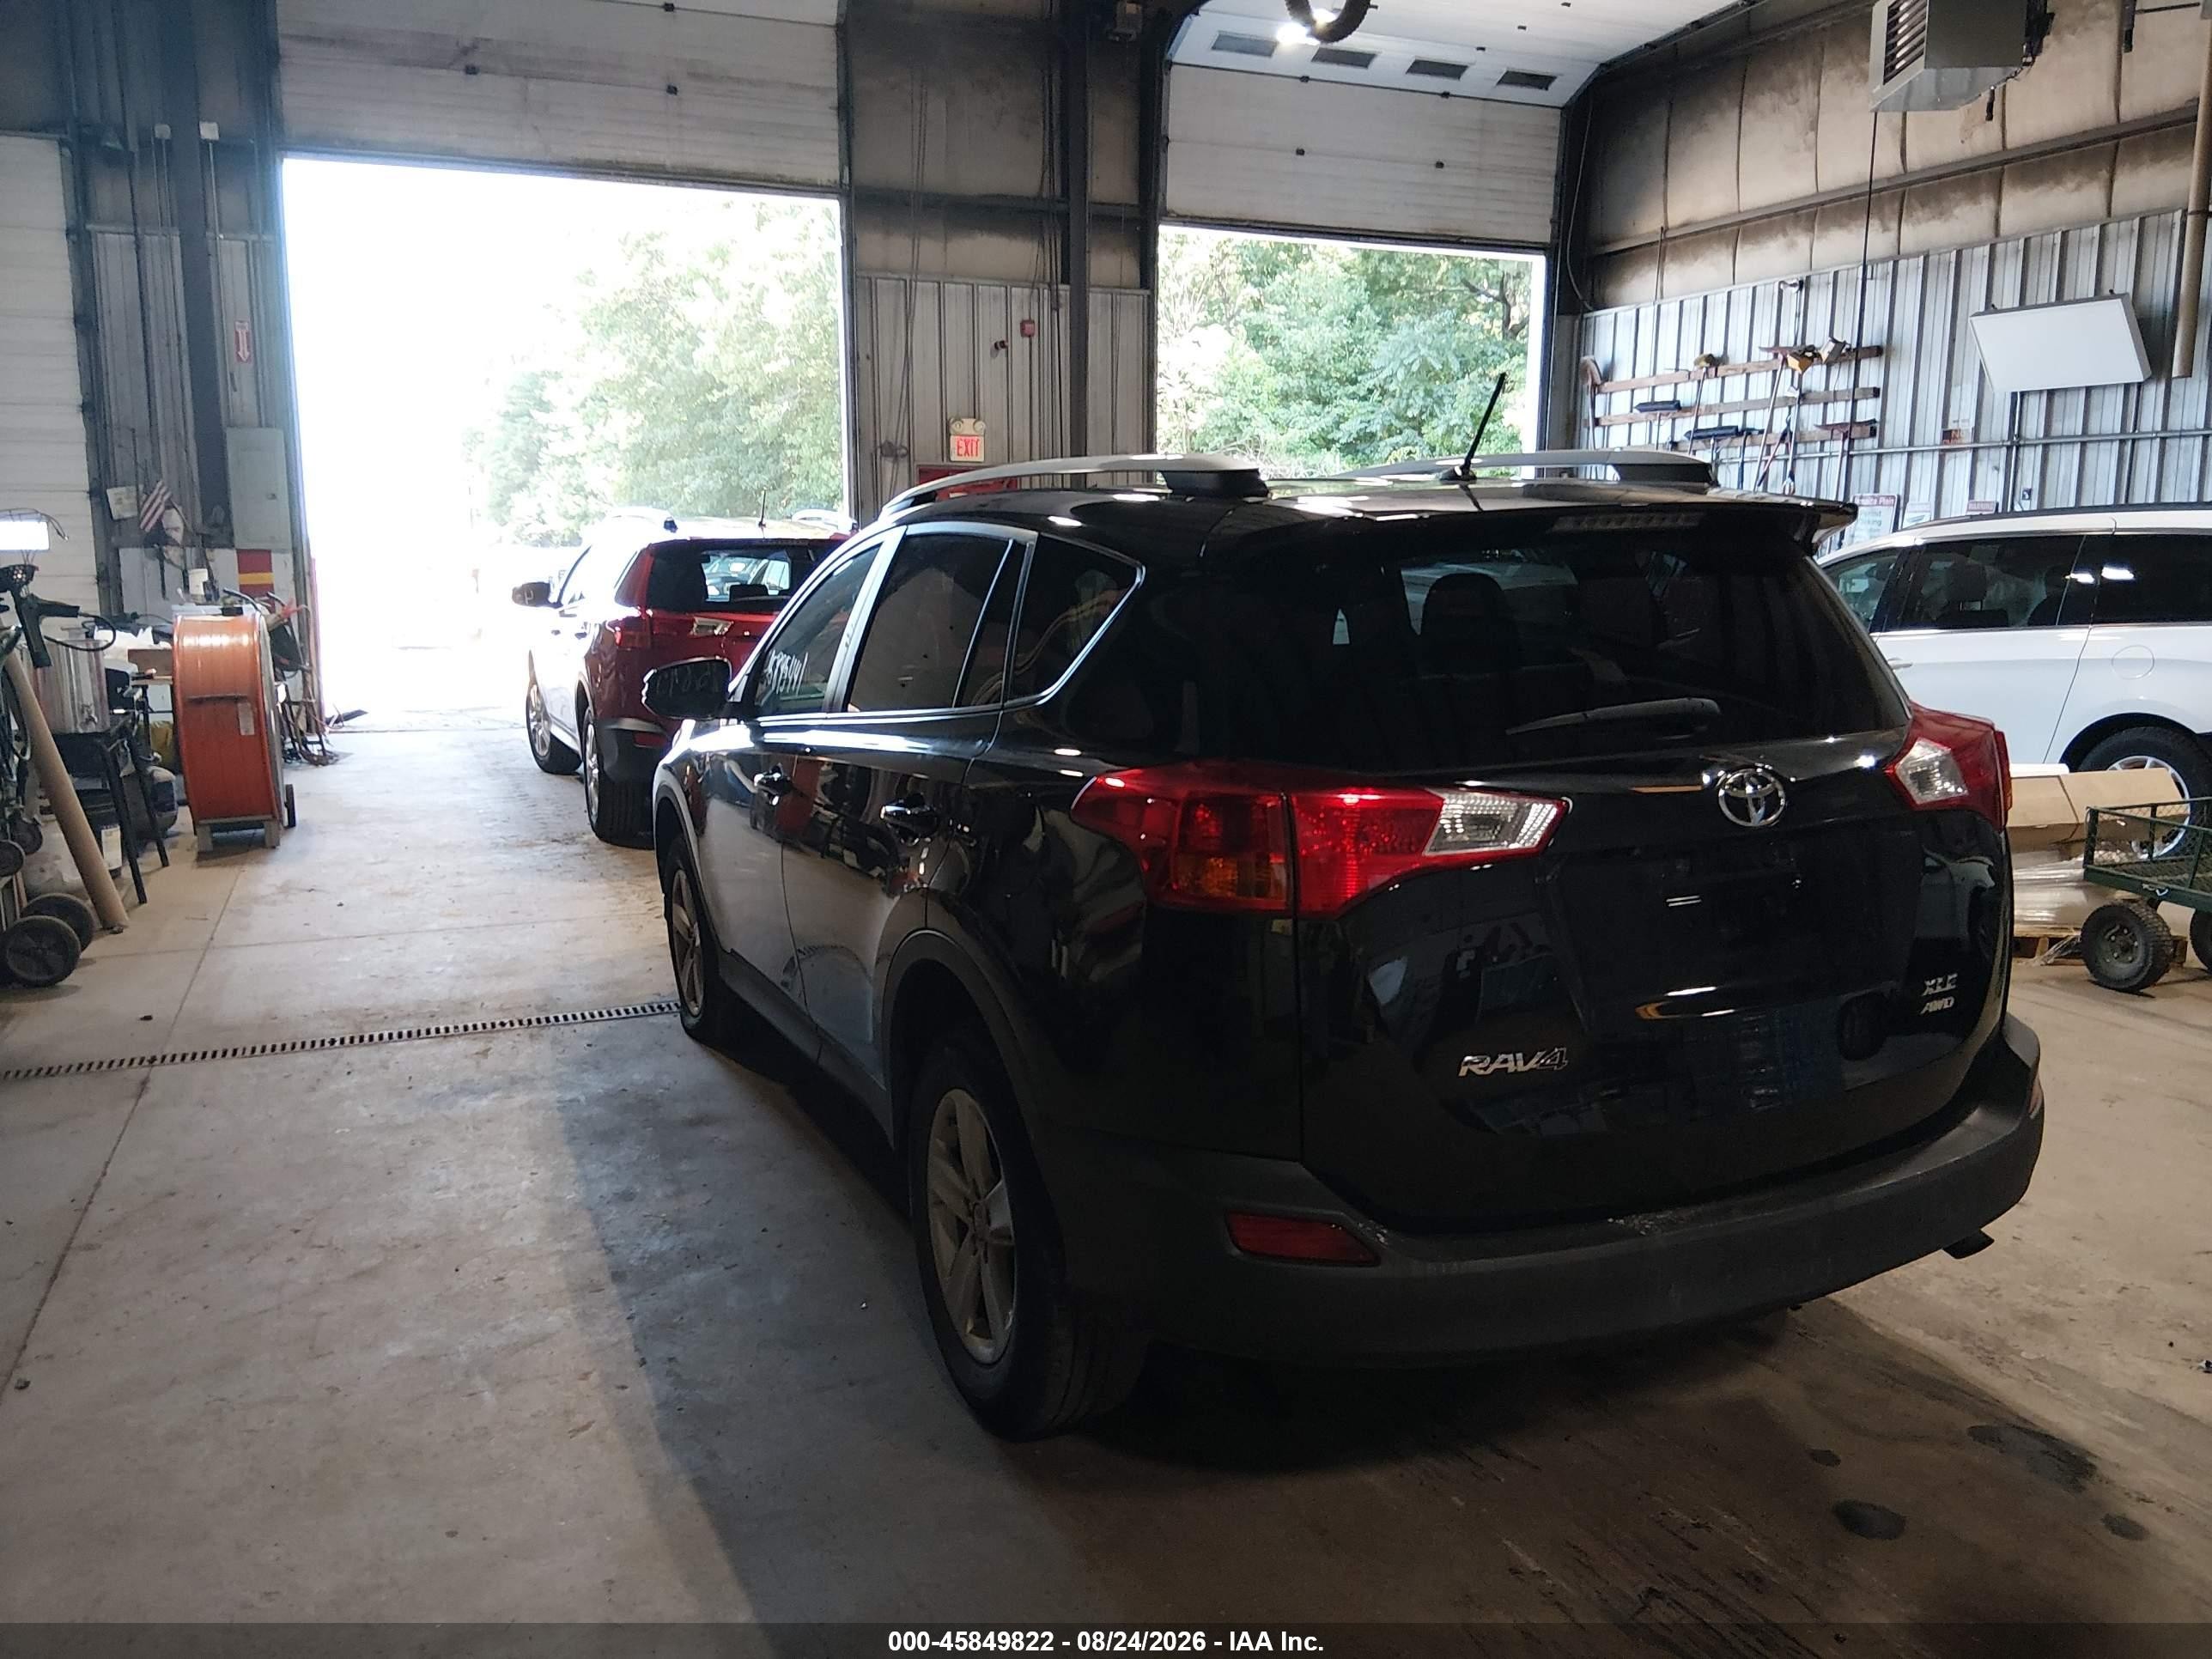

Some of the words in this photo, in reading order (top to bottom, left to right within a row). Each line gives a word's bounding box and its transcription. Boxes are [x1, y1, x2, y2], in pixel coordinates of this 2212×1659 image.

[957, 438, 981, 457] EXIT
[1922, 973, 1958, 996] XLE
[1919, 997, 1955, 1014] AWD
[1457, 1046, 1569, 1078] RAV4
